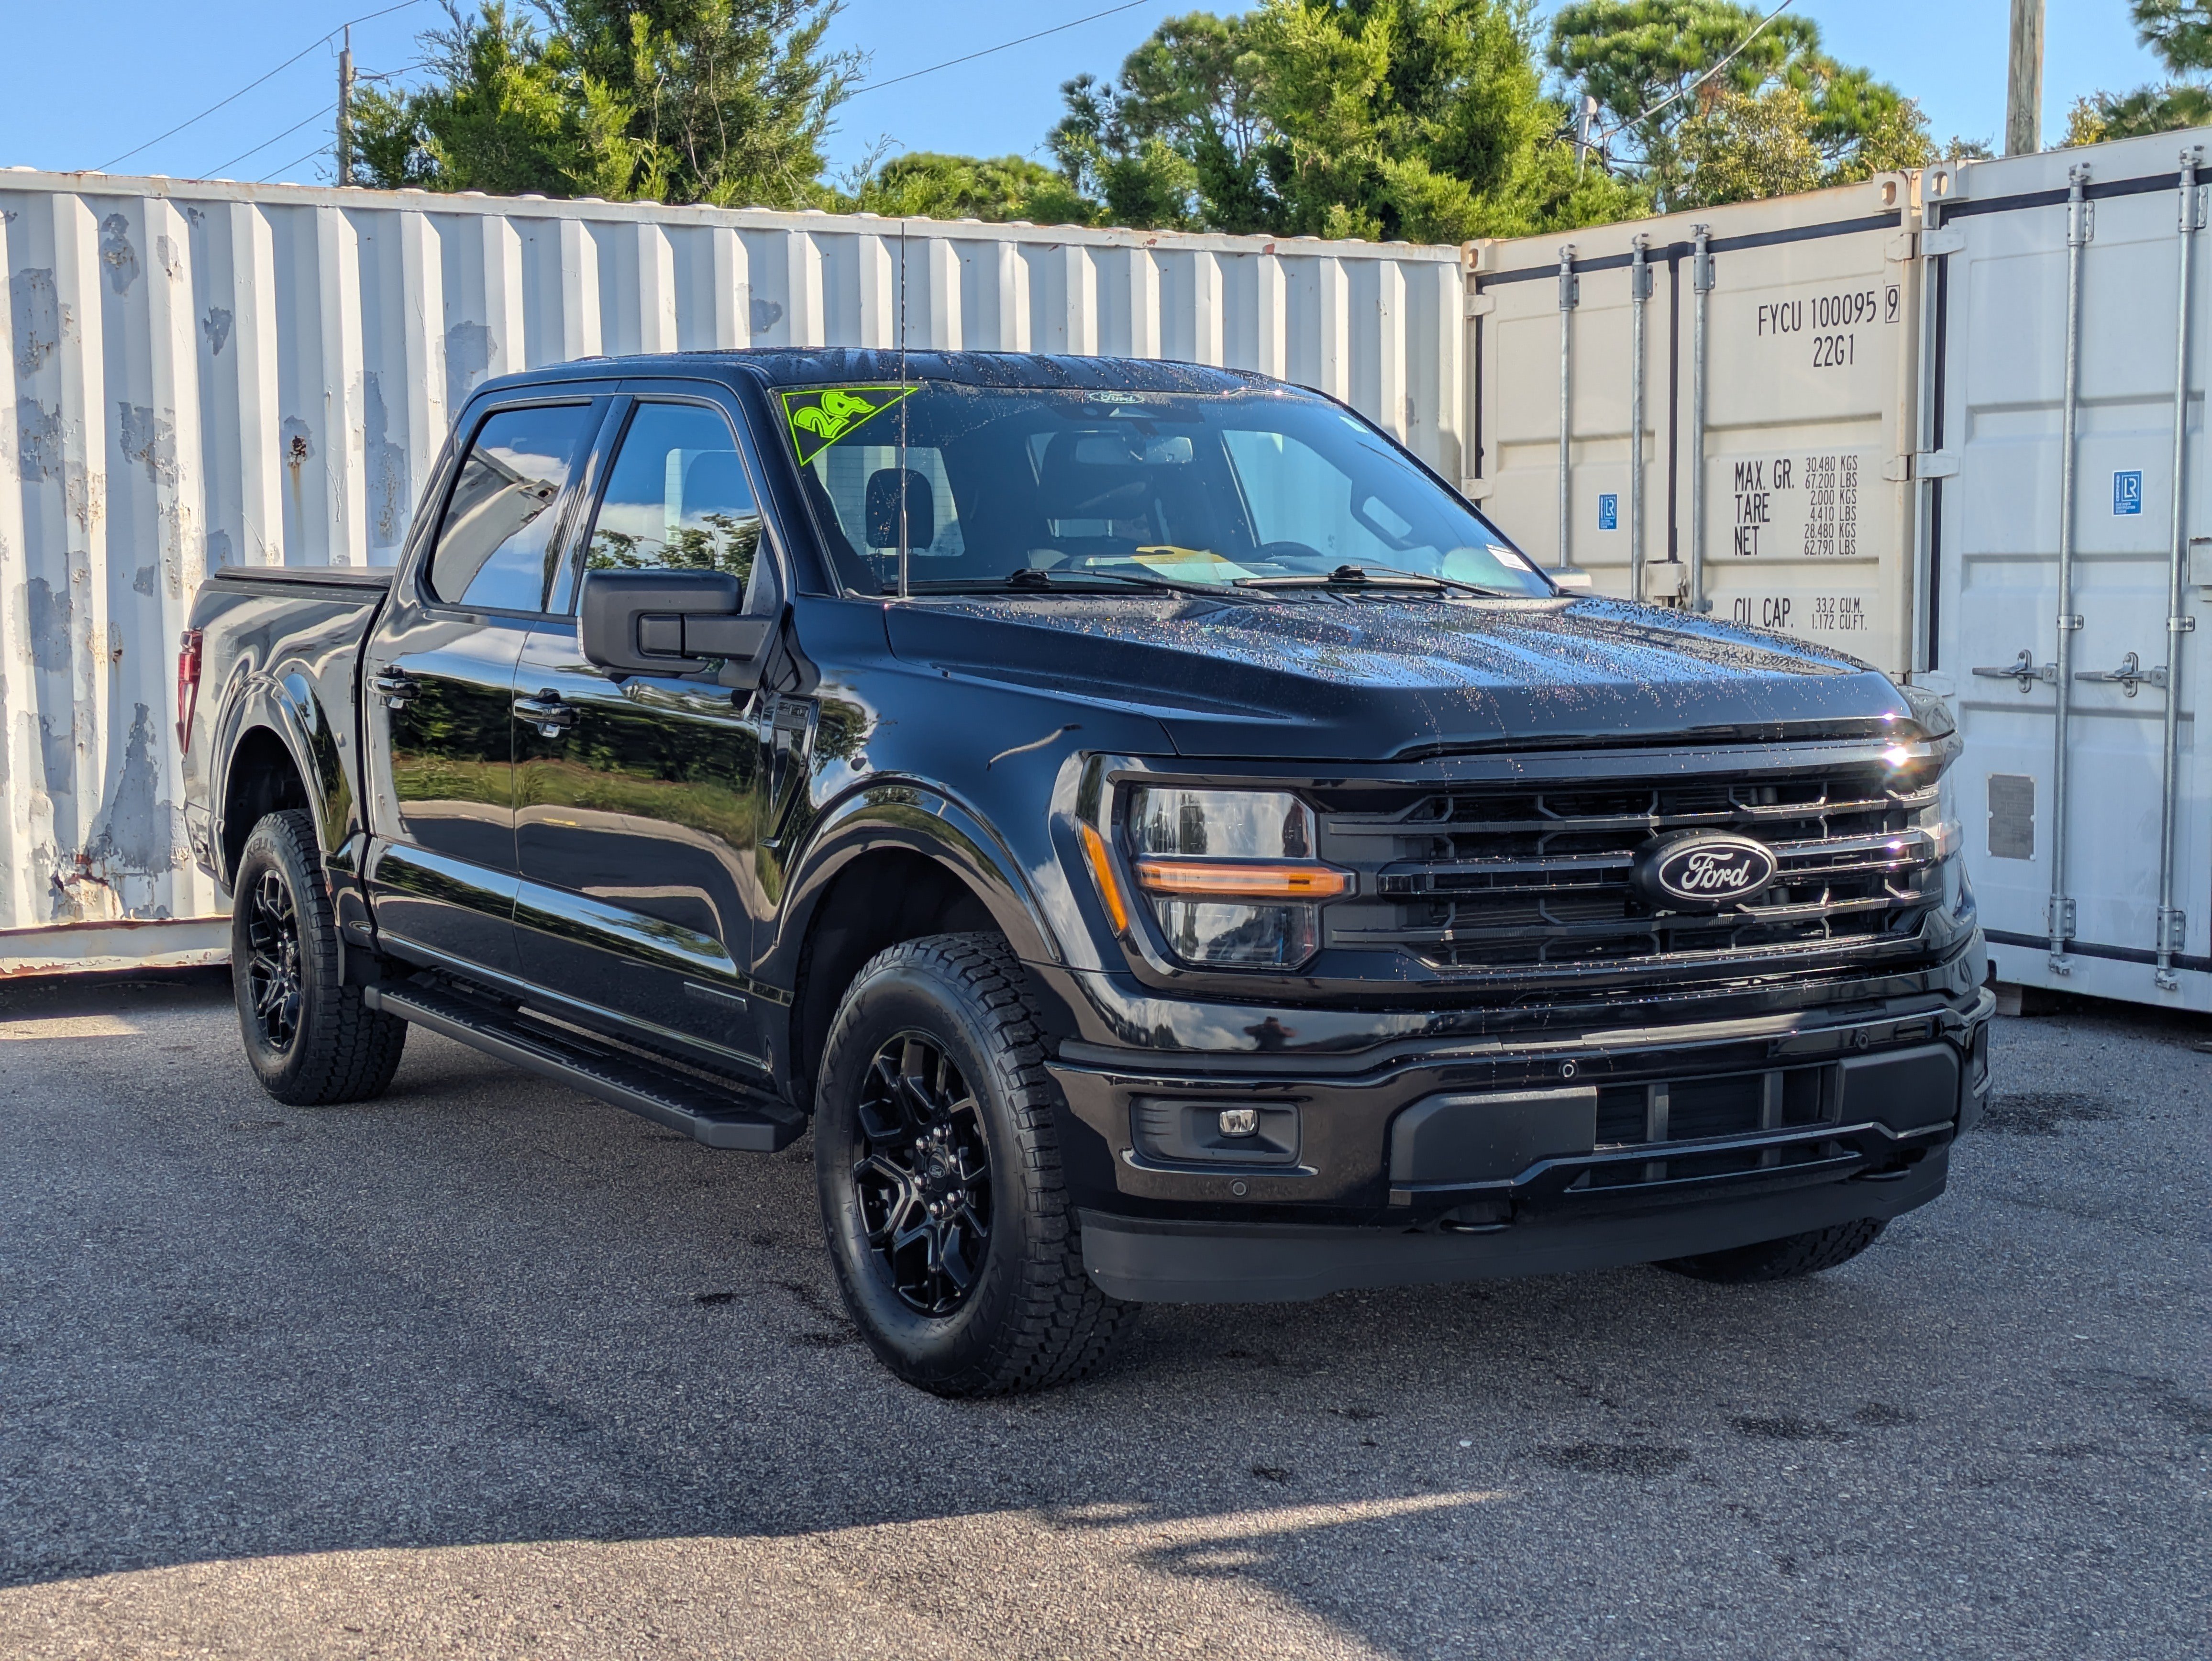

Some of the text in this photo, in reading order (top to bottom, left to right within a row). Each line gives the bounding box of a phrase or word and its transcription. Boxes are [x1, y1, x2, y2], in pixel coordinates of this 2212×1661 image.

[1759, 288, 1898, 336] FYCU 100095 9
[1813, 333, 1854, 368] 22G1
[1100, 392, 1136, 402] Ford
[1735, 458, 1794, 492] MAX. GR.
[1840, 455, 1858, 472] KGS
[1840, 472, 1858, 488] LBS
[1735, 492, 1770, 524] TARE
[1839, 488, 1857, 505] KGS
[1839, 505, 1857, 522] LBS
[1734, 525, 1760, 556] NET
[1839, 522, 1856, 539] KGS
[1839, 539, 1856, 555] LBS
[1763, 597, 1793, 628] CAP.
[1681, 852, 1751, 890] Ford
